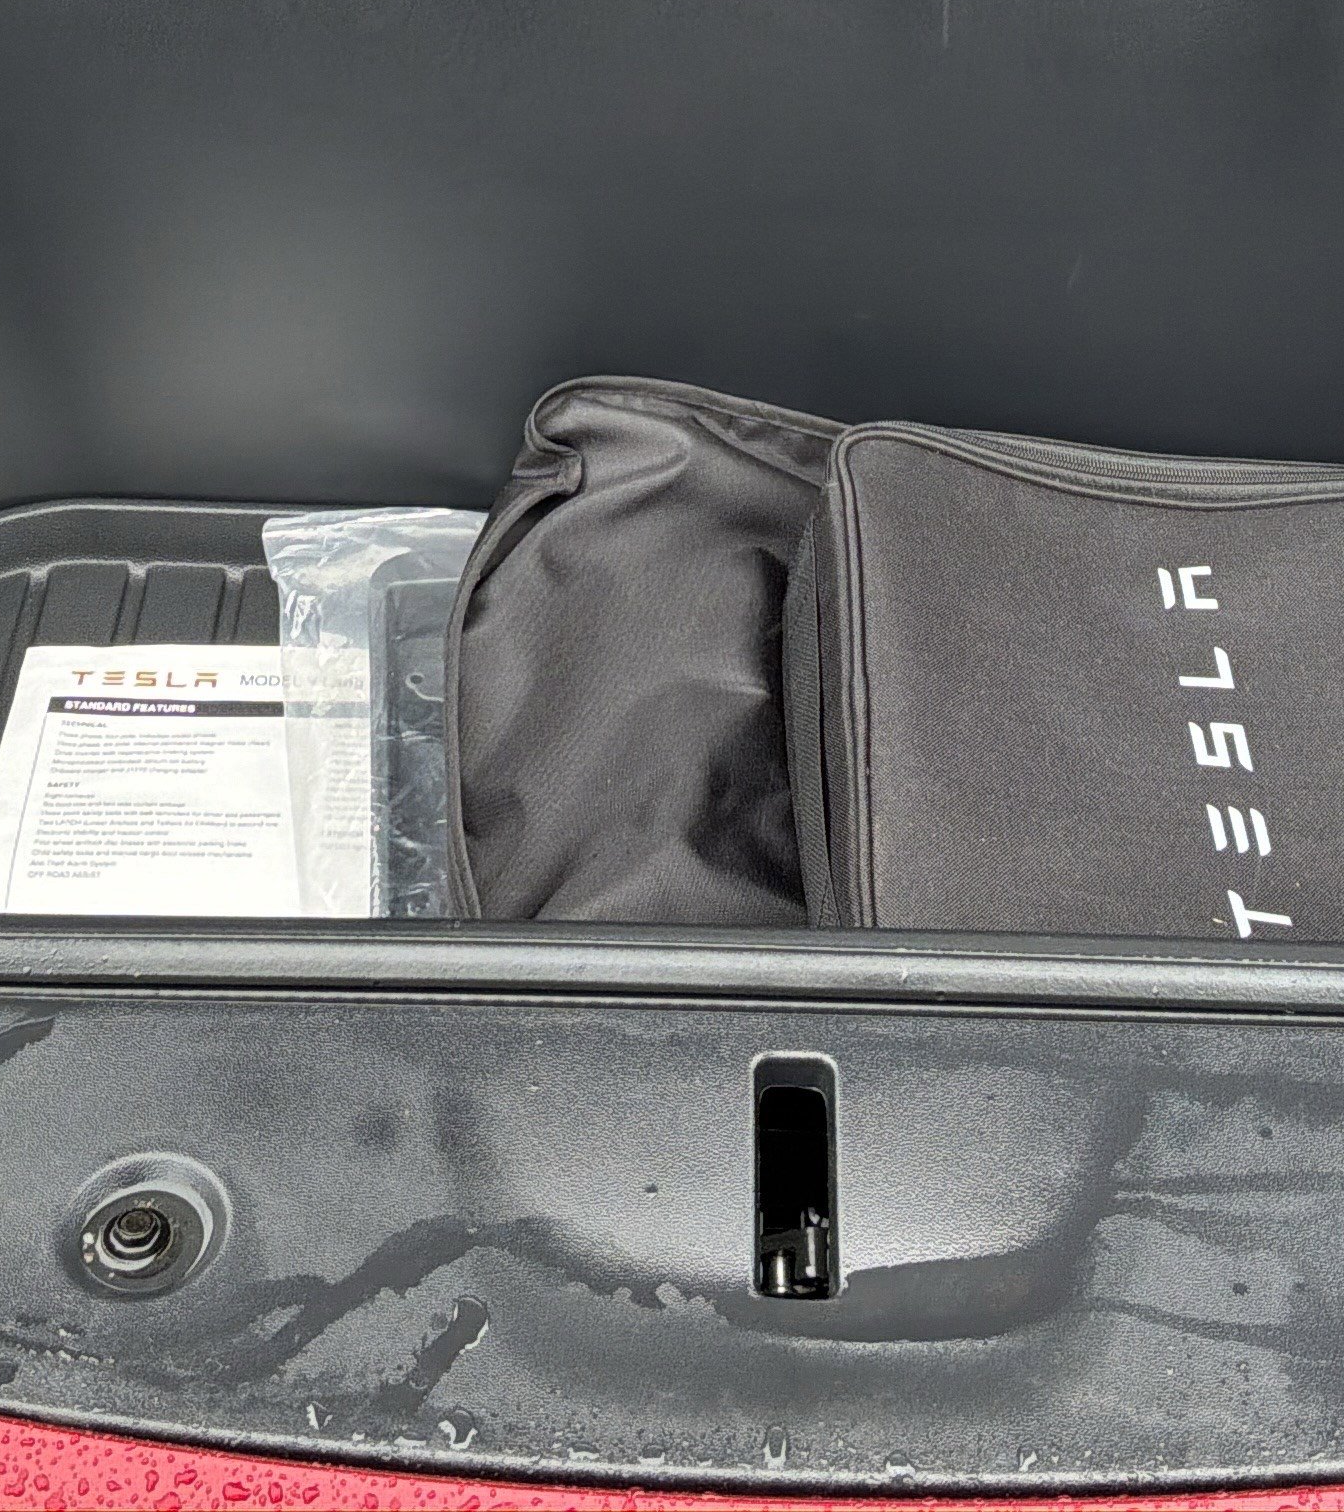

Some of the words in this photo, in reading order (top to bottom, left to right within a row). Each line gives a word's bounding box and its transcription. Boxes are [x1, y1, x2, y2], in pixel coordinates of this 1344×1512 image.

[71, 670, 219, 688] TESLA
[62, 700, 131, 713] STANDARD
[132, 702, 196, 714] FEATURES
[1157, 565, 1293, 939] TESLA
